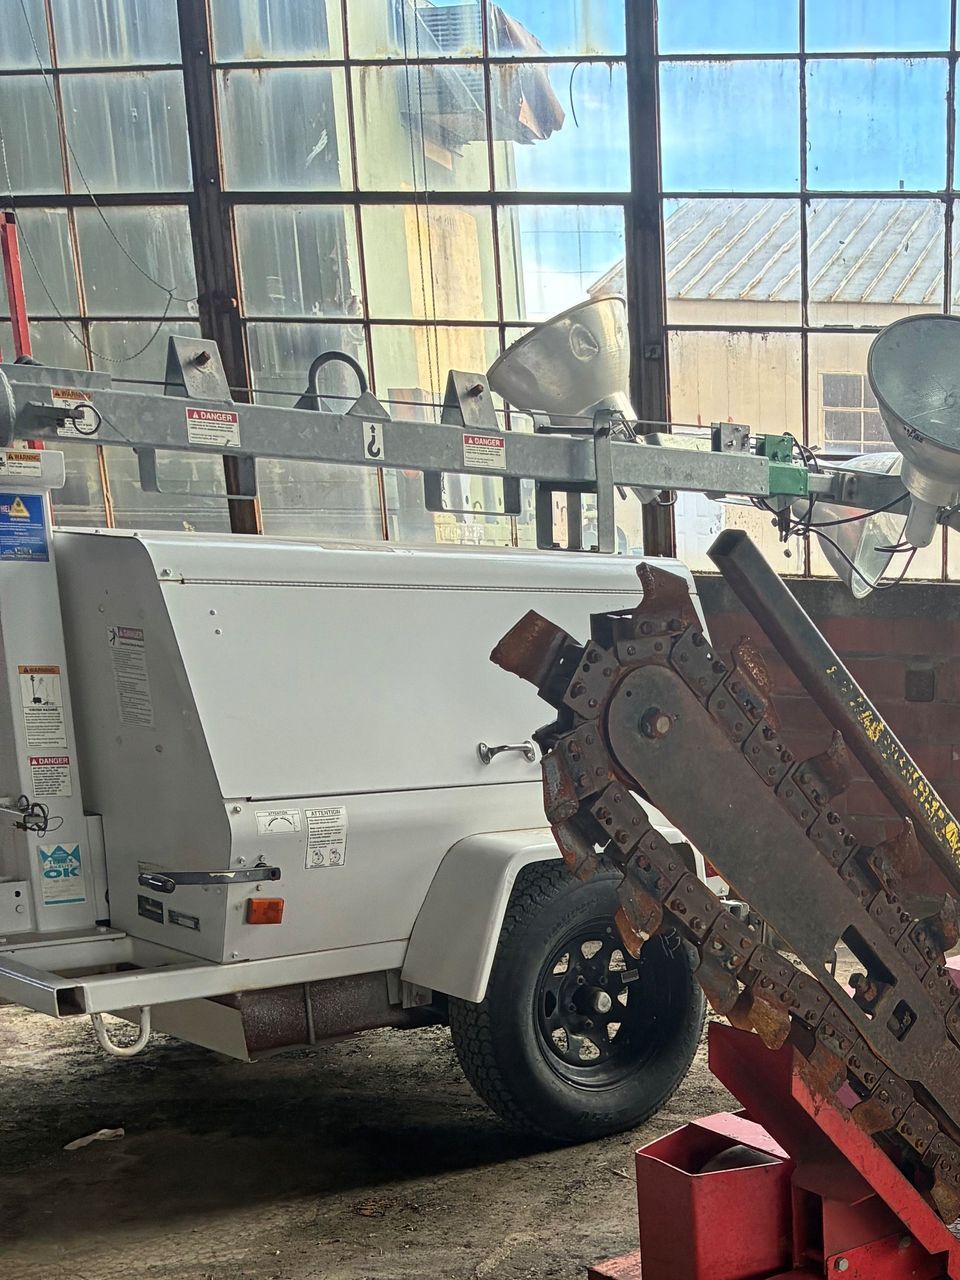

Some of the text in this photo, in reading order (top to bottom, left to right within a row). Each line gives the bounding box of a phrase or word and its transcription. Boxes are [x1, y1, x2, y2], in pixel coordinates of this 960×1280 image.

[200, 411, 233, 422] DANGER
[474, 437, 501, 446] DANGER
[43, 868, 80, 879] OK
